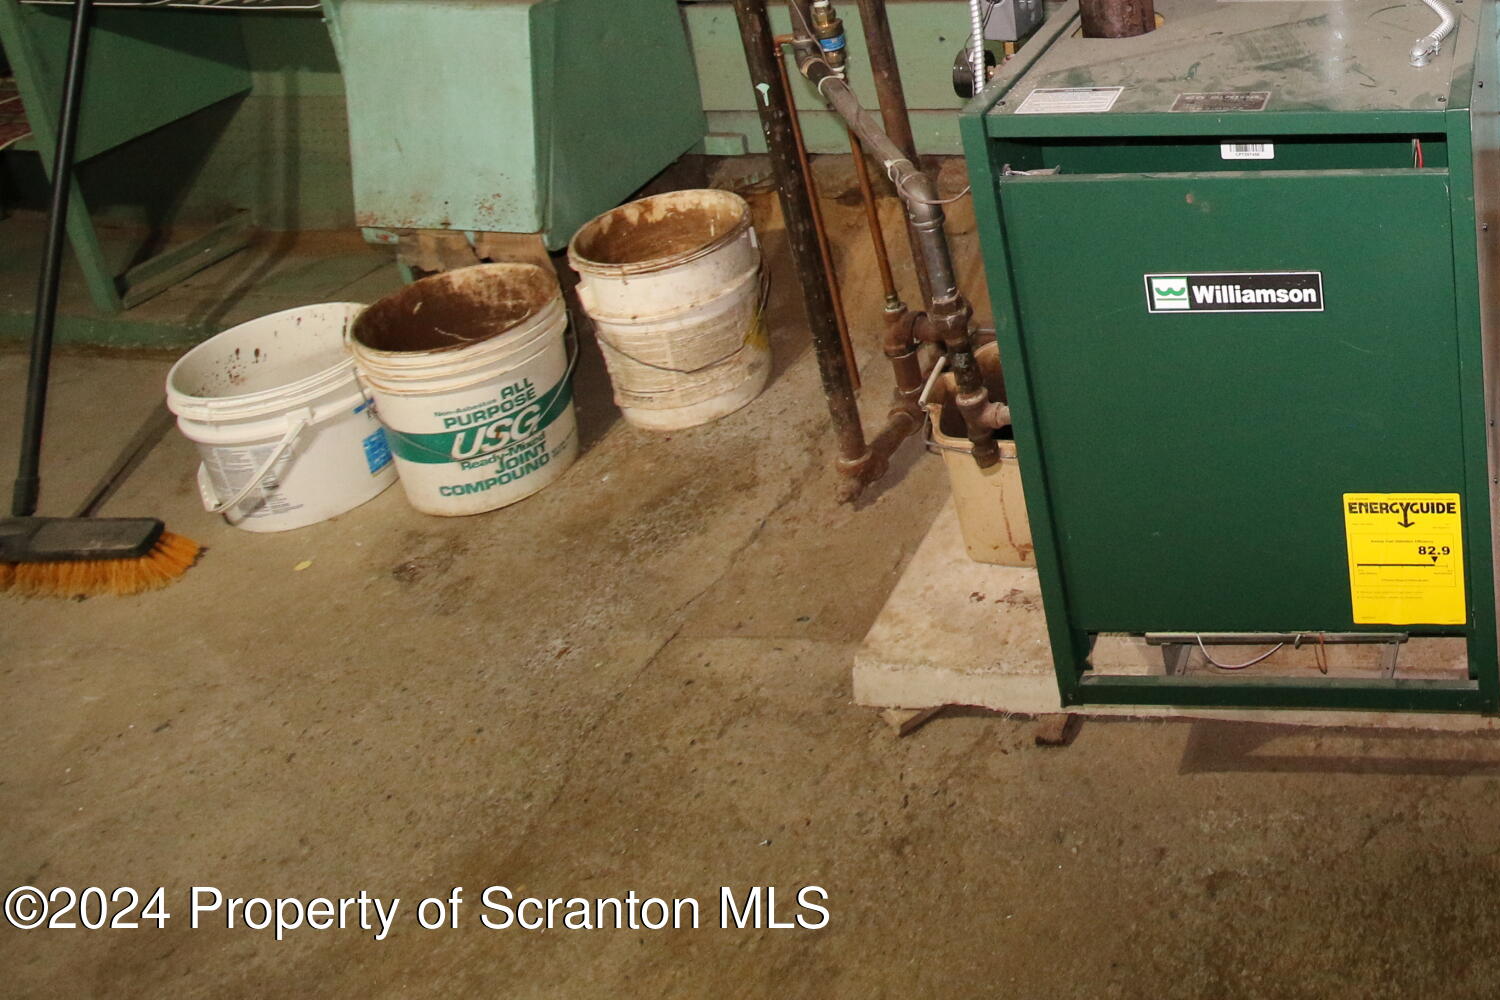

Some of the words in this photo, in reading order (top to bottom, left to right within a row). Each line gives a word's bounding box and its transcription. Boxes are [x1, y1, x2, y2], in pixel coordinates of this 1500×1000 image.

[1192, 284, 1317, 304] Williamson
[500, 377, 534, 400] ALL
[443, 387, 537, 429] PURPOSE
[451, 404, 542, 461] USG
[495, 440, 547, 474] JOINT
[439, 452, 550, 497] COMPOUND
[1418, 546, 1451, 556] 82.9
